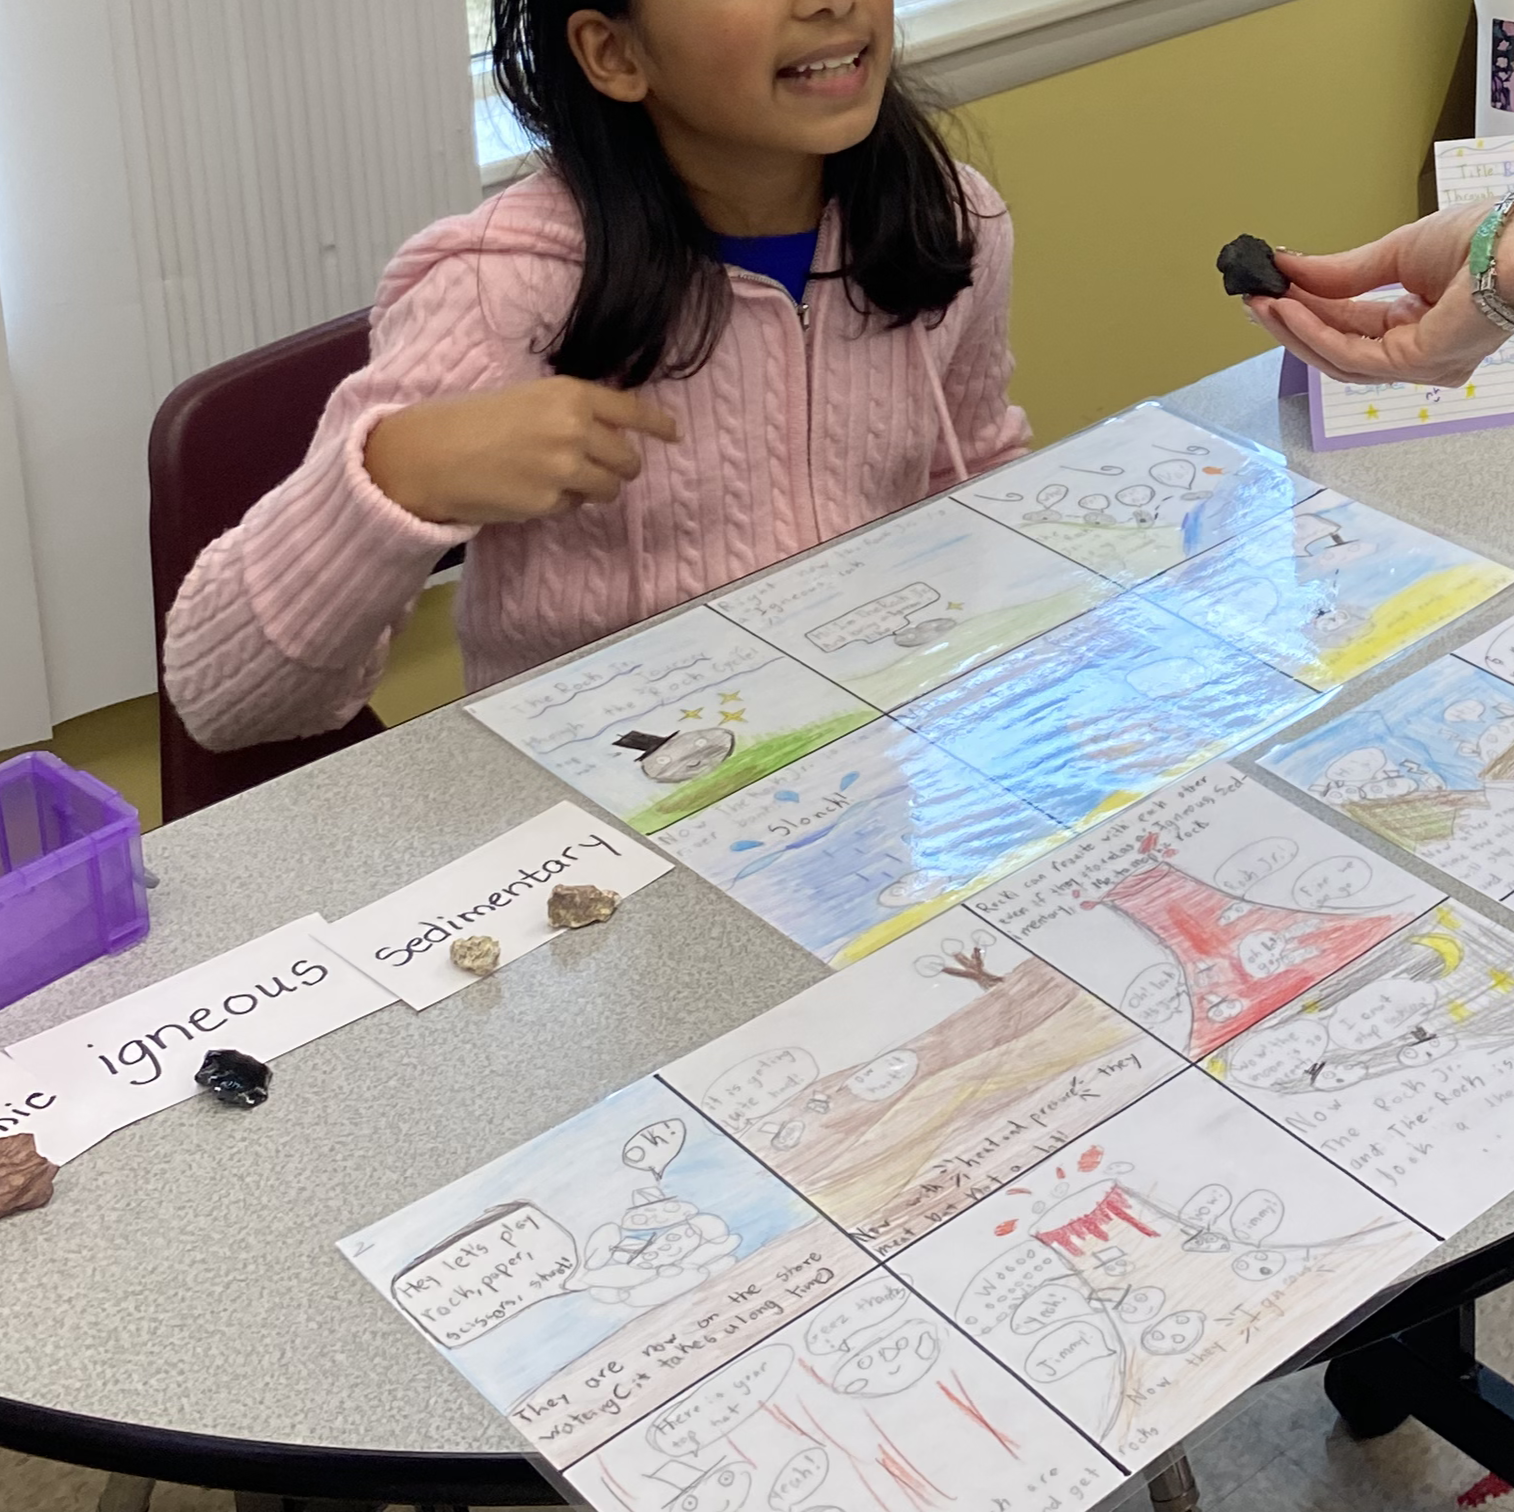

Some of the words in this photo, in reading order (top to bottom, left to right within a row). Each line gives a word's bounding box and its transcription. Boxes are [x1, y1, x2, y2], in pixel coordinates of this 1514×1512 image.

[657, 818, 706, 846] Now
[1023, 873, 1047, 889] can
[1100, 823, 1130, 842] with
[1132, 798, 1170, 824] each
[1173, 774, 1212, 799] other
[375, 833, 622, 967] Sedimentary
[86, 955, 329, 1087] igneous
[1267, 1031, 1299, 1048] the
[954, 1137, 1000, 1168] heat
[996, 1116, 1030, 1142] and
[1095, 1050, 1146, 1081] they
[1284, 1091, 1342, 1134] Now
[1317, 1125, 1363, 1154] The
[1372, 1079, 1426, 1112] Rock
[1345, 1140, 1389, 1171] and
[1386, 1113, 1429, 1138] The
[1433, 1075, 1486, 1106] Rock
[397, 1270, 442, 1301] Hey
[441, 1243, 489, 1271] let's
[495, 1210, 543, 1250] play
[420, 1285, 483, 1322] rock,
[481, 1251, 533, 1293] paper,
[511, 1388, 571, 1427] They
[584, 1360, 625, 1389] are
[641, 1333, 677, 1357] now
[694, 1310, 721, 1331] on
[725, 1280, 763, 1306] the
[657, 1325, 718, 1369] takes
[733, 1296, 785, 1329] long
[1035, 1330, 1091, 1377] Jimmy!
[1124, 1376, 1172, 1407] Now
[1184, 1340, 1227, 1367] they
[706, 1400, 743, 1428] hat
